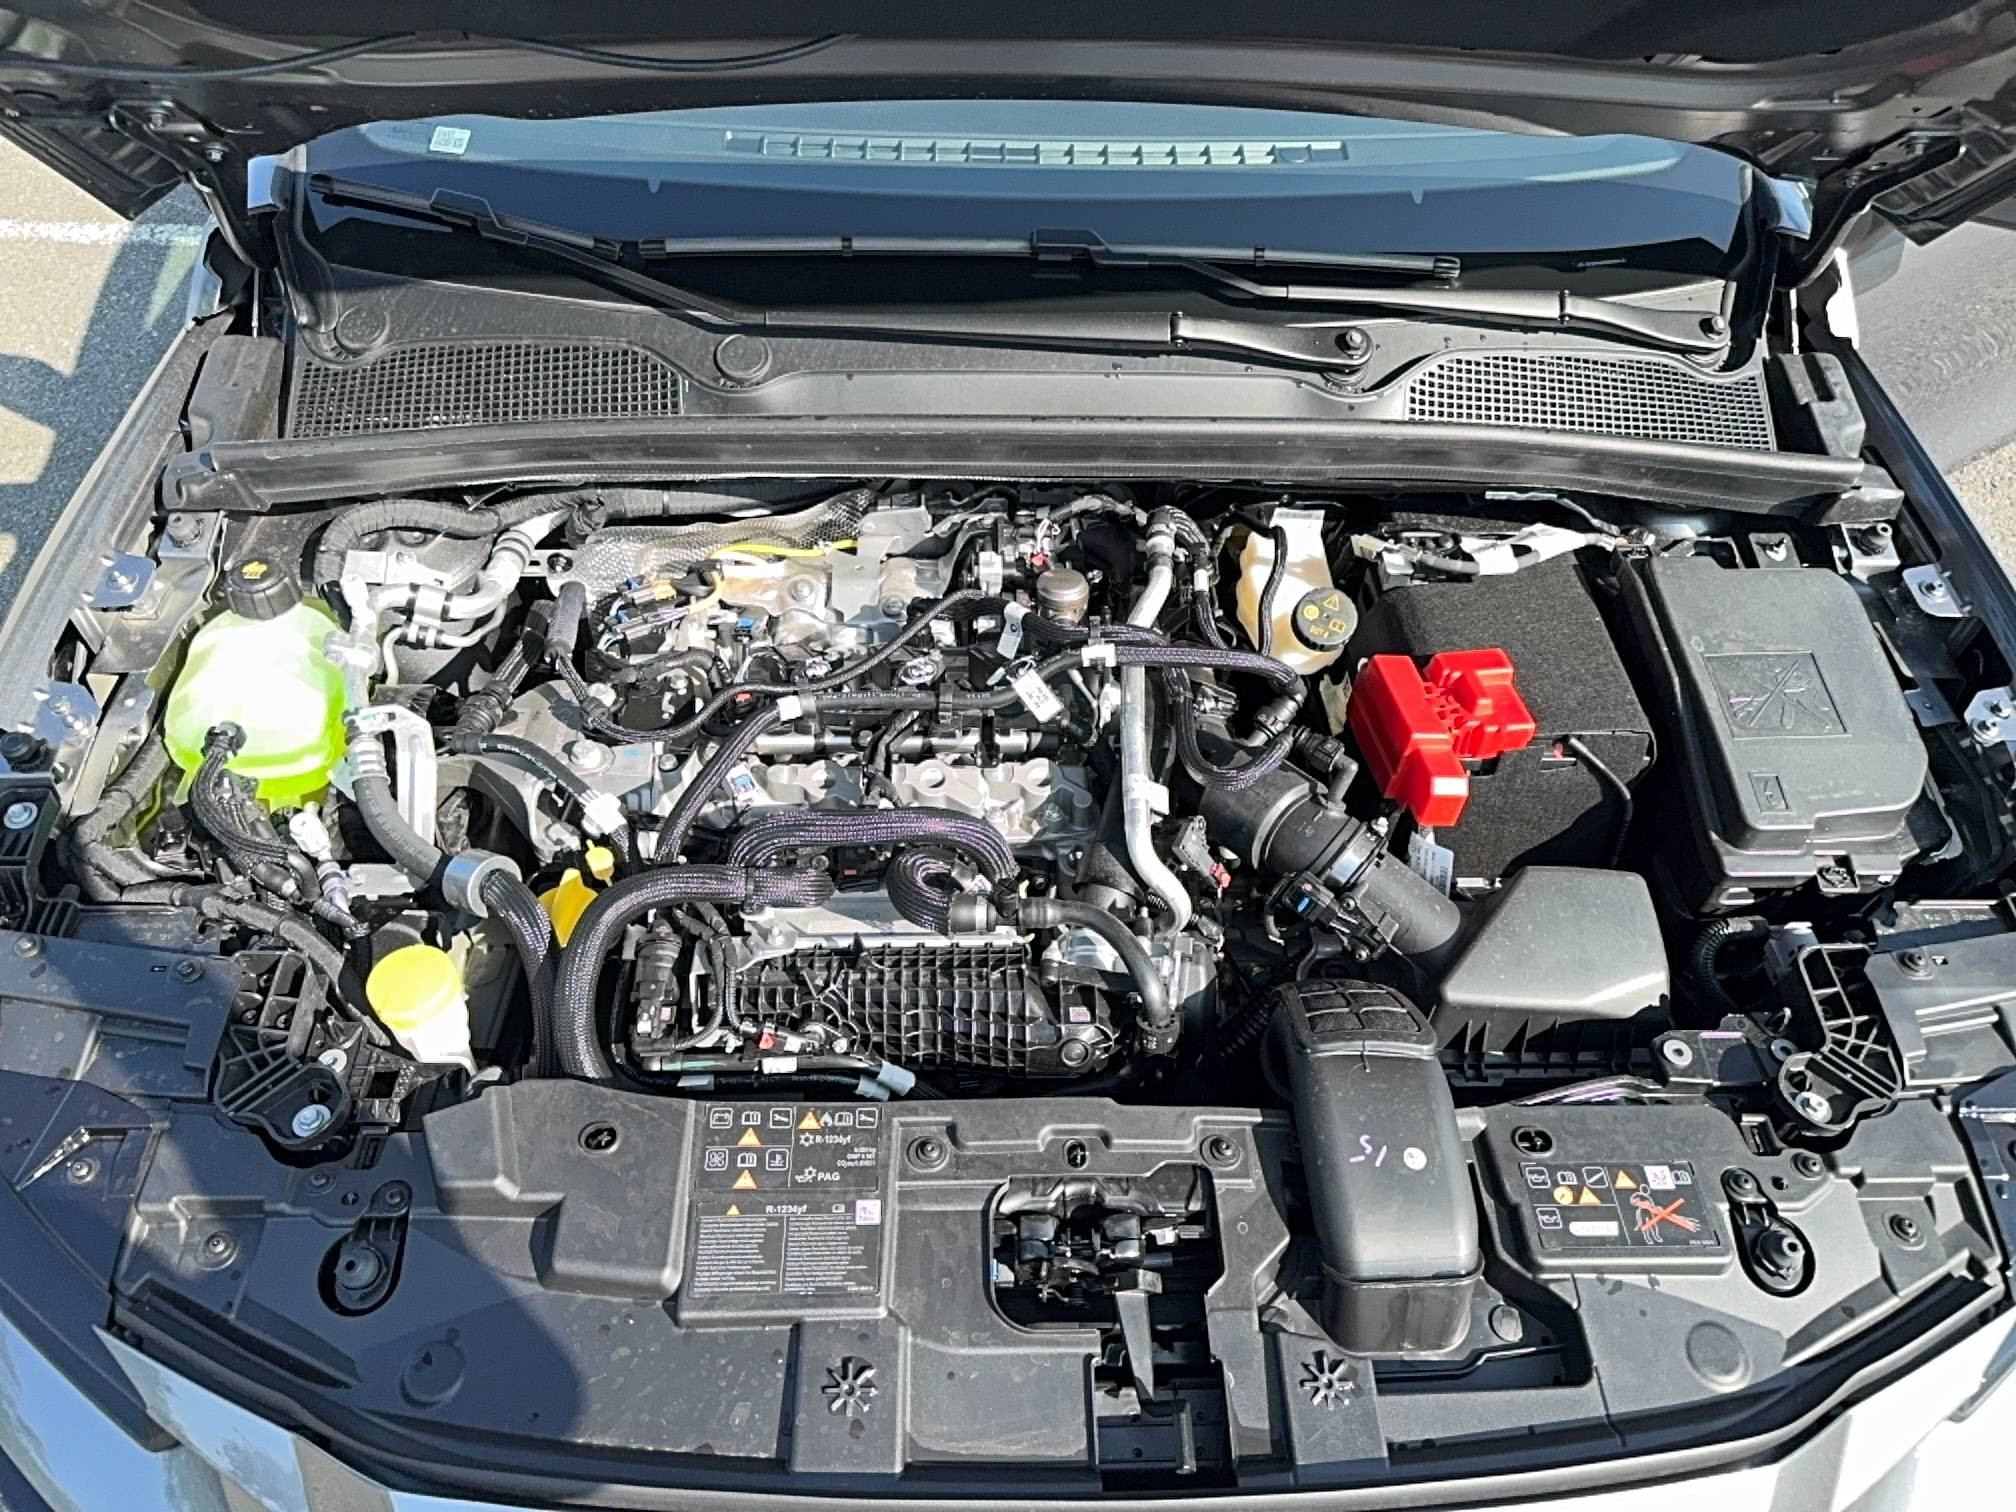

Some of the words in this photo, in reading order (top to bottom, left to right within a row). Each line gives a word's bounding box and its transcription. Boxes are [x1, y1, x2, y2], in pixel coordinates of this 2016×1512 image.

[815, 1134, 851, 1145] R-1234yf
[817, 1171, 841, 1181] PAG
[765, 1204, 807, 1215] R-1234yf
